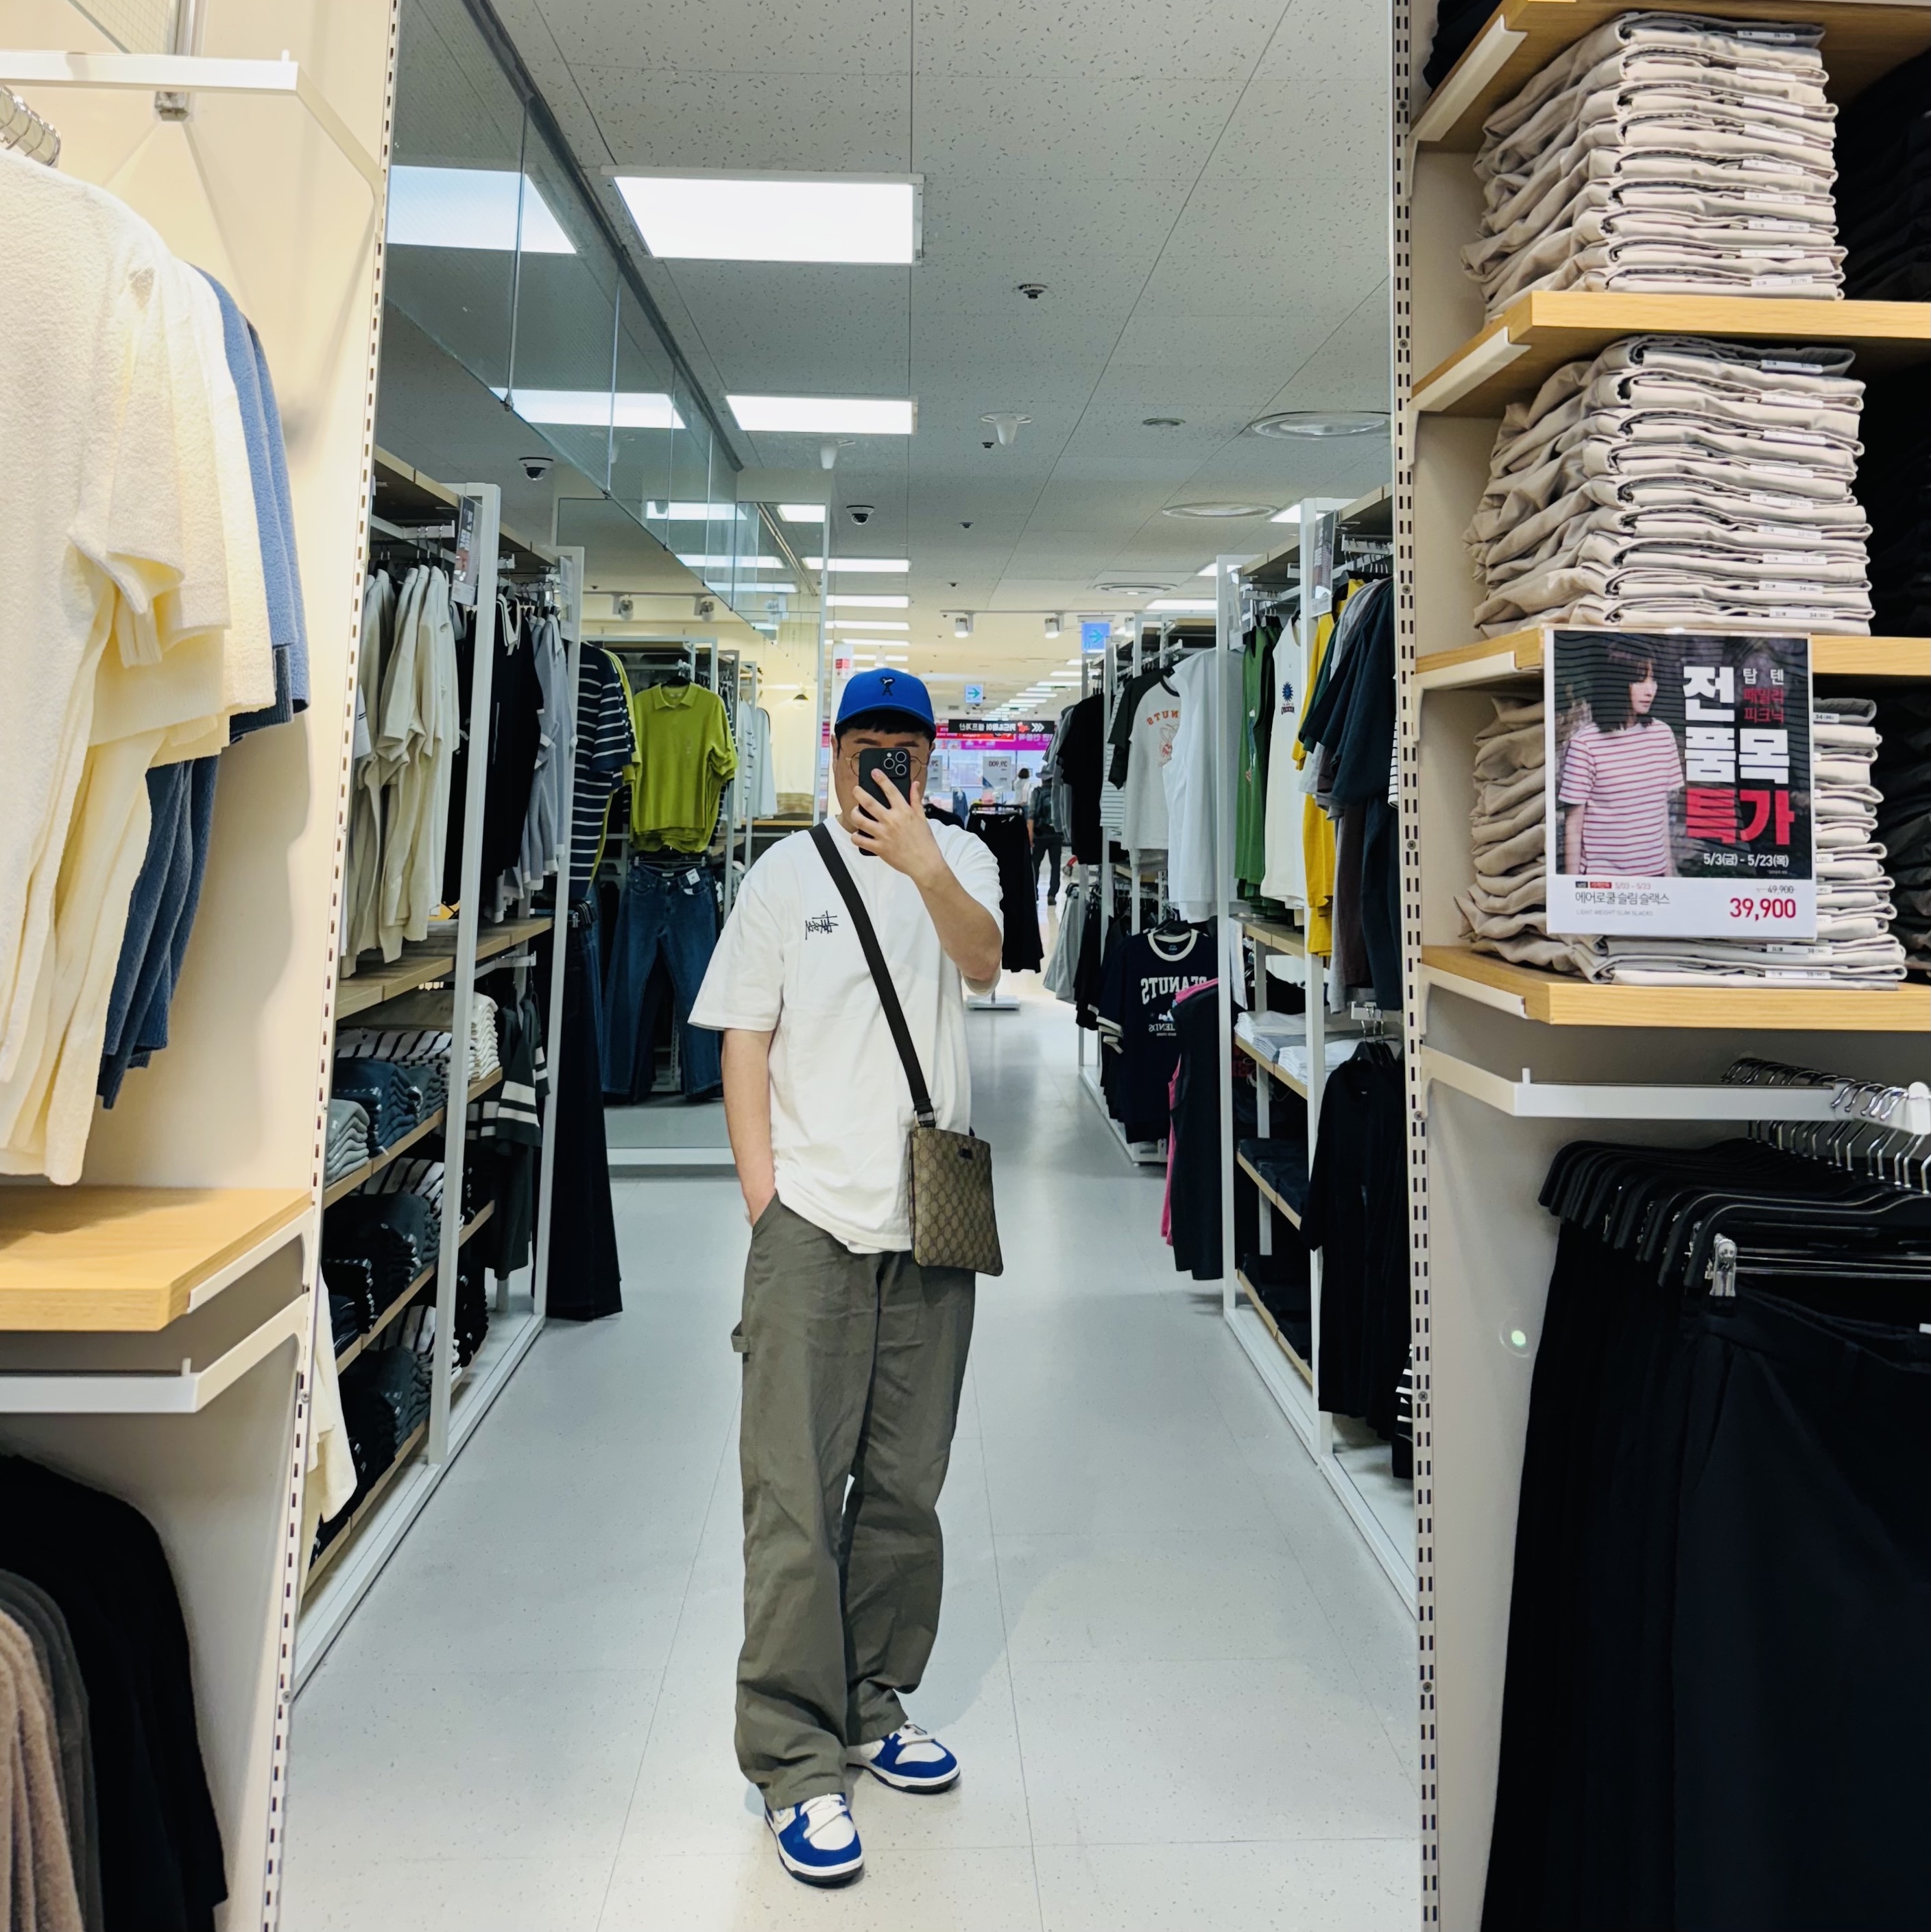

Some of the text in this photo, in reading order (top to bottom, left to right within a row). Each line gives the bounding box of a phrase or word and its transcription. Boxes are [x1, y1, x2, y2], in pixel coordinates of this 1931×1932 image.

[1686, 787, 1795, 845] 특가
[1703, 852, 1738, 866] 5/3(금)
[1747, 854, 1789, 868] 5/23(목)
[1575, 892, 1670, 905] 에어로쿨 슬림 슬랙스
[1729, 897, 1796, 921] 39,900
